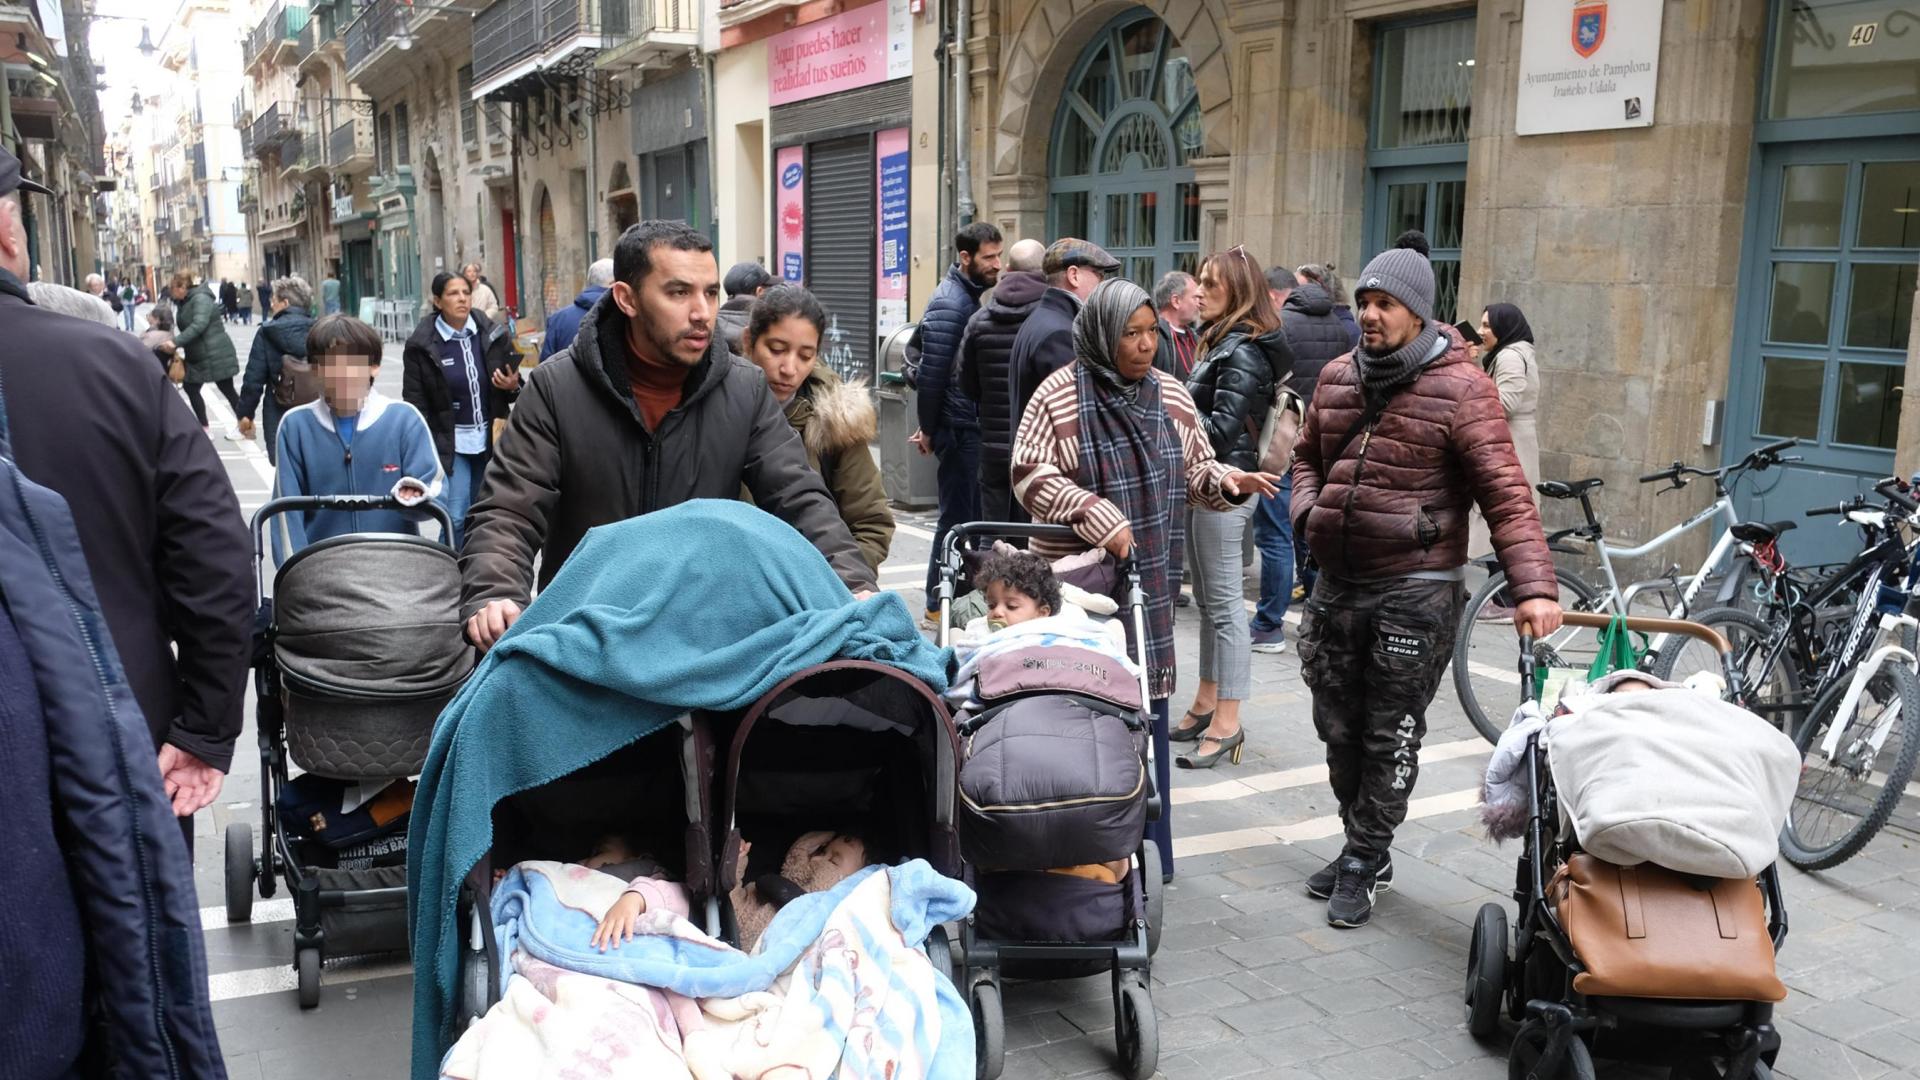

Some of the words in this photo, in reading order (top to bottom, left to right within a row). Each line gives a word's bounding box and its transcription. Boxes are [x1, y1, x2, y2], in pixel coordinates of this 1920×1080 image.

[1851, 25, 1875, 44] 40
[797, 31, 831, 65] puedes
[832, 26, 862, 49] hacer
[774, 63, 811, 94] realidad
[813, 65, 828, 84] tus
[830, 54, 866, 80] sueños
[1524, 67, 1587, 89] Ayuntamiento
[1589, 64, 1601, 78] de
[1603, 60, 1651, 78] Pamplona
[1553, 82, 1587, 97] Iruñeko
[1589, 80, 1617, 95] Udala
[1388, 635, 1419, 646] BLACK
[1387, 646, 1419, 656] SQUAD
[338, 846, 367, 858] WITH
[368, 845, 390, 856] THIS
